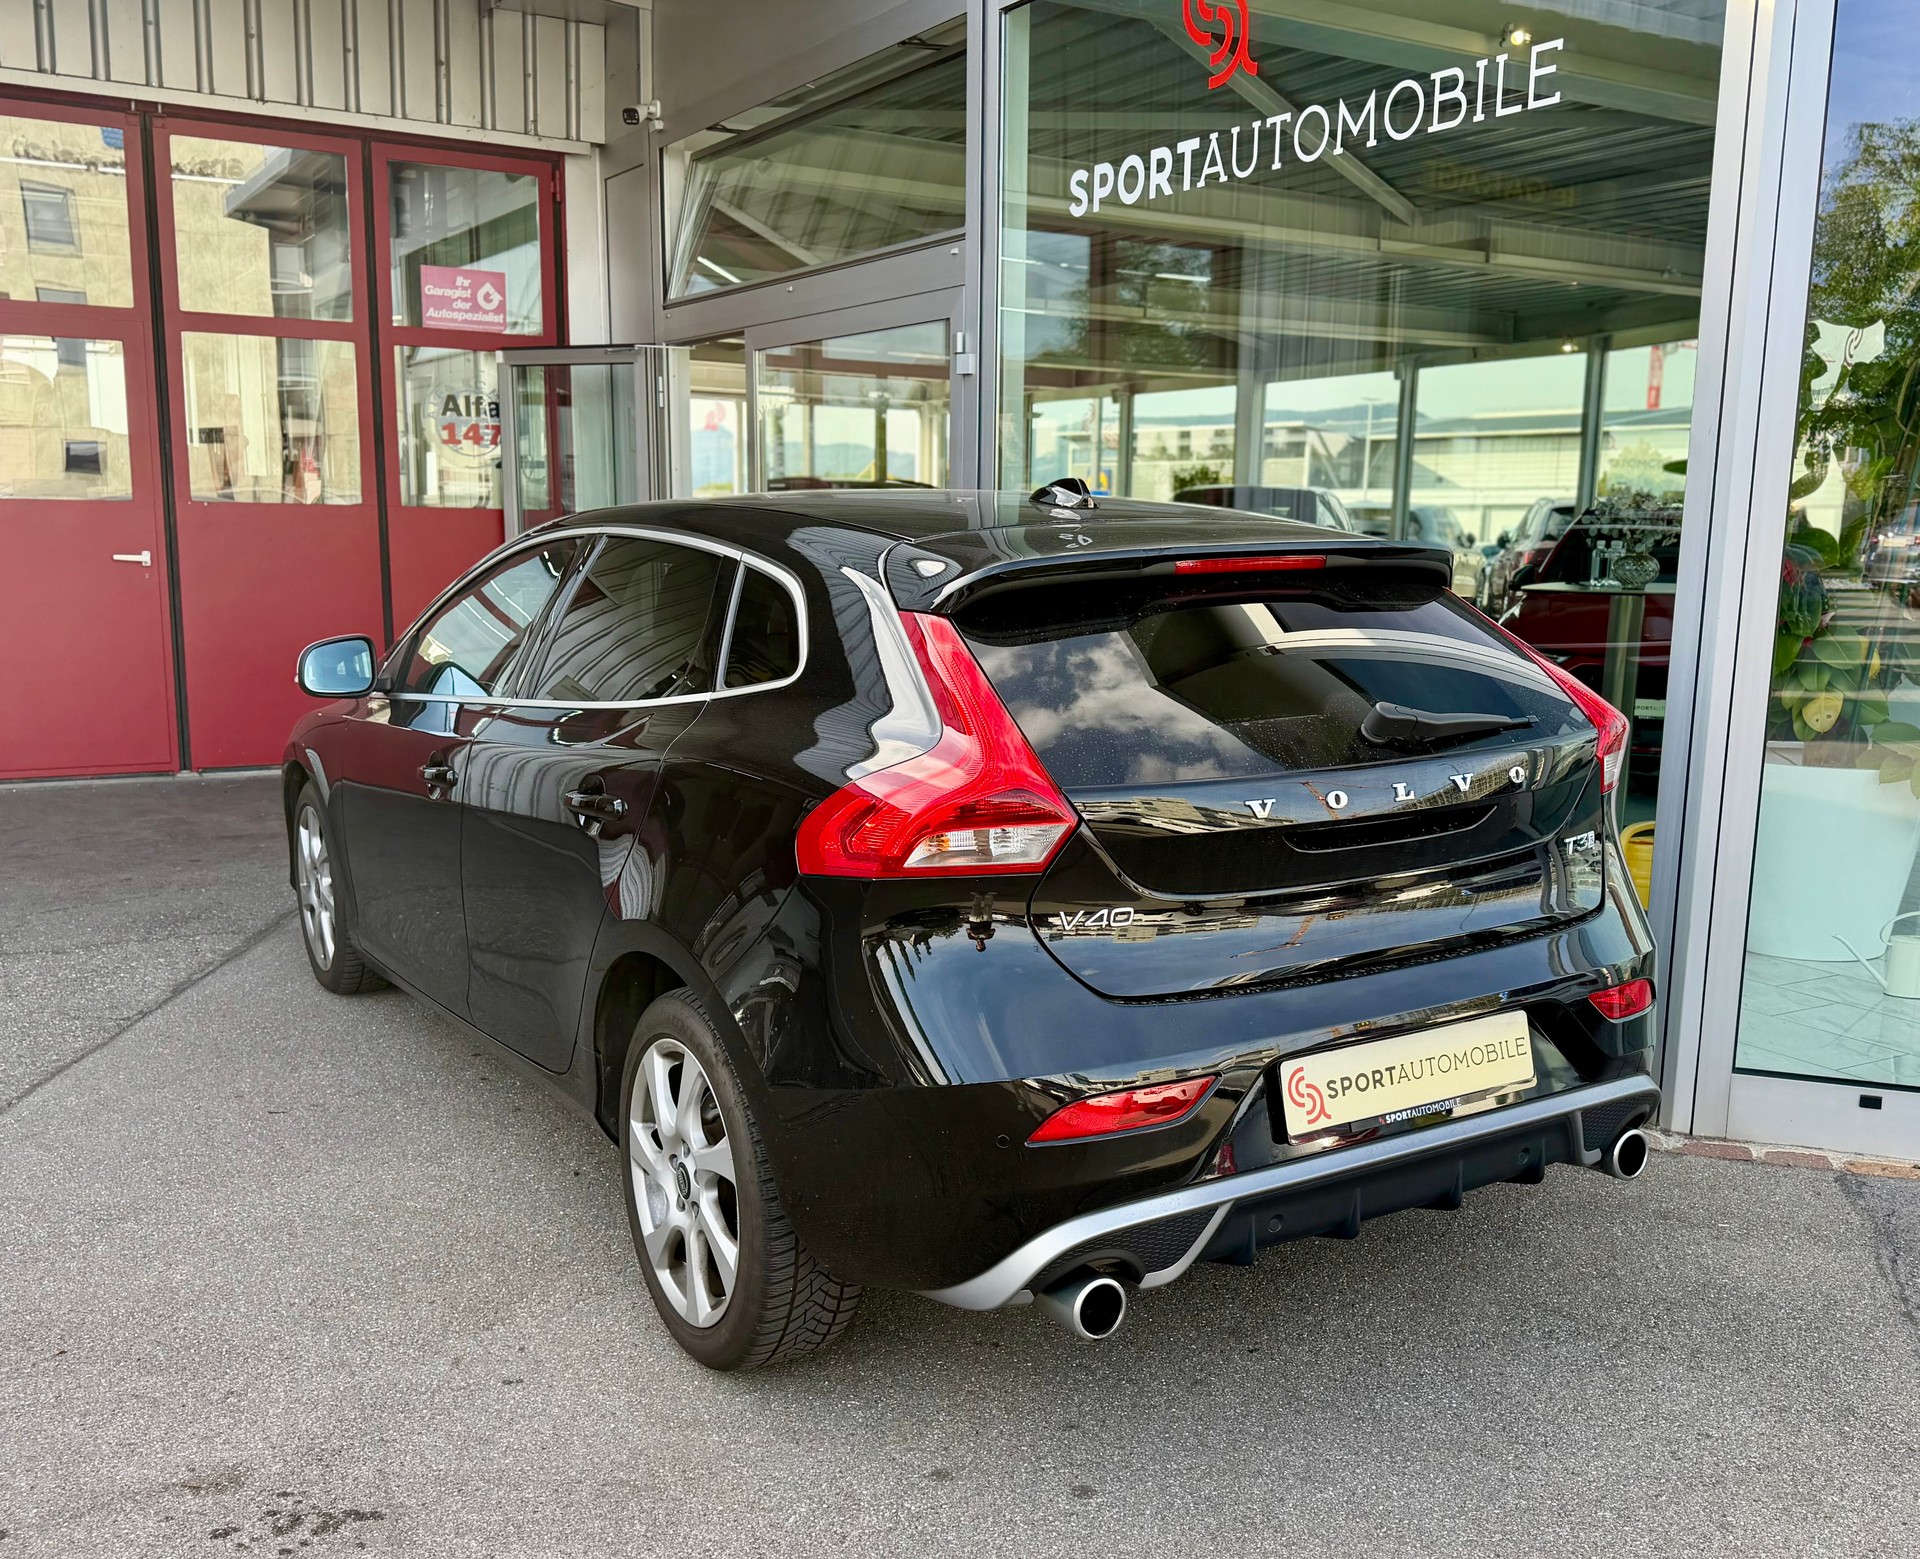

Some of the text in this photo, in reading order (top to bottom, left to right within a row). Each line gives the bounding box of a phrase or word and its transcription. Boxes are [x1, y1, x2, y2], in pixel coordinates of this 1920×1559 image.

[1069, 38, 1564, 218] SPORTAUTOMOBILE
[424, 284, 472, 299] Garagist
[455, 276, 472, 287] Ihr
[426, 307, 505, 323] Autospezialist
[452, 299, 472, 310] der
[441, 394, 500, 418] Alfa
[441, 422, 501, 446] 147
[1245, 766, 1525, 819] VOLVO
[1059, 907, 1134, 930] V40
[1326, 1037, 1527, 1099] SPORTAUTOMOBILE
[1385, 1098, 1462, 1124] SPORTAUTOMOBILE
